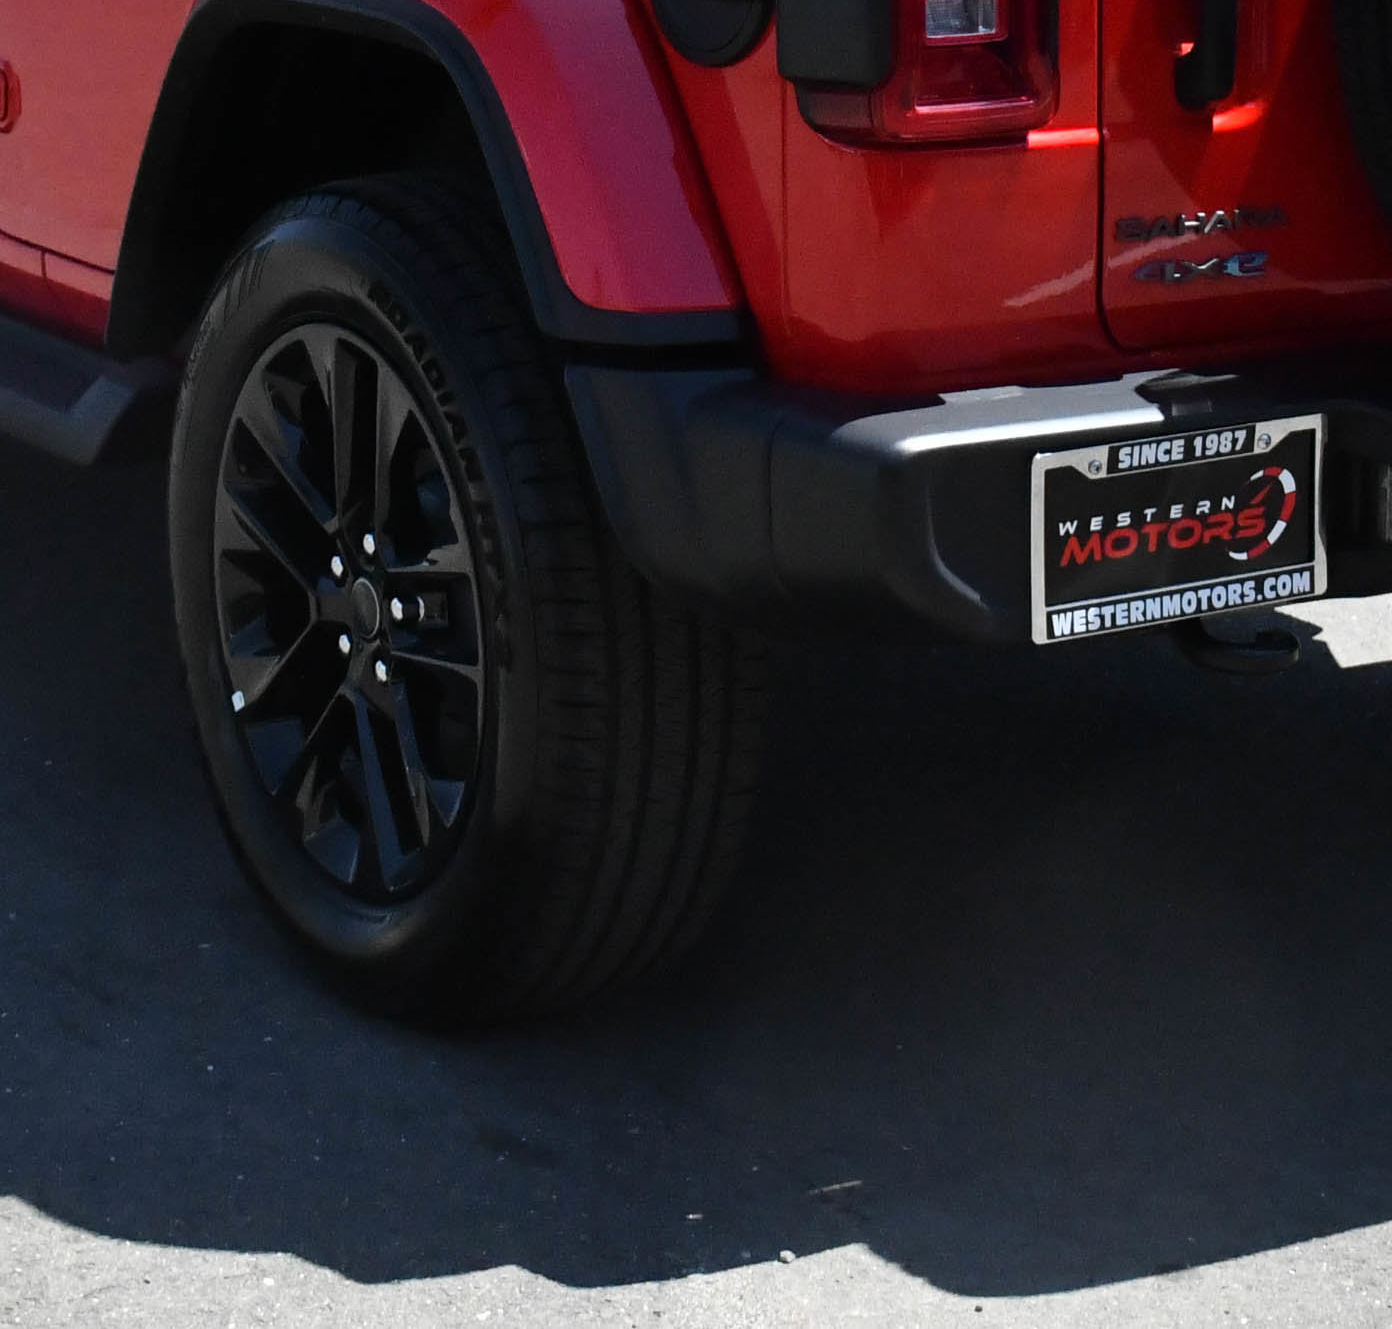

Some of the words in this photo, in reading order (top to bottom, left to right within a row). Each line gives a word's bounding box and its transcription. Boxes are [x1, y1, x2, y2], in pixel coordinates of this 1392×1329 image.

[1118, 438, 1185, 469] SINCE
[1193, 430, 1247, 458] 1987
[1058, 495, 1236, 536] WESTERN
[1060, 506, 1267, 567] MOTORS
[1051, 571, 1311, 637] WESTERNMOTORS.COM
